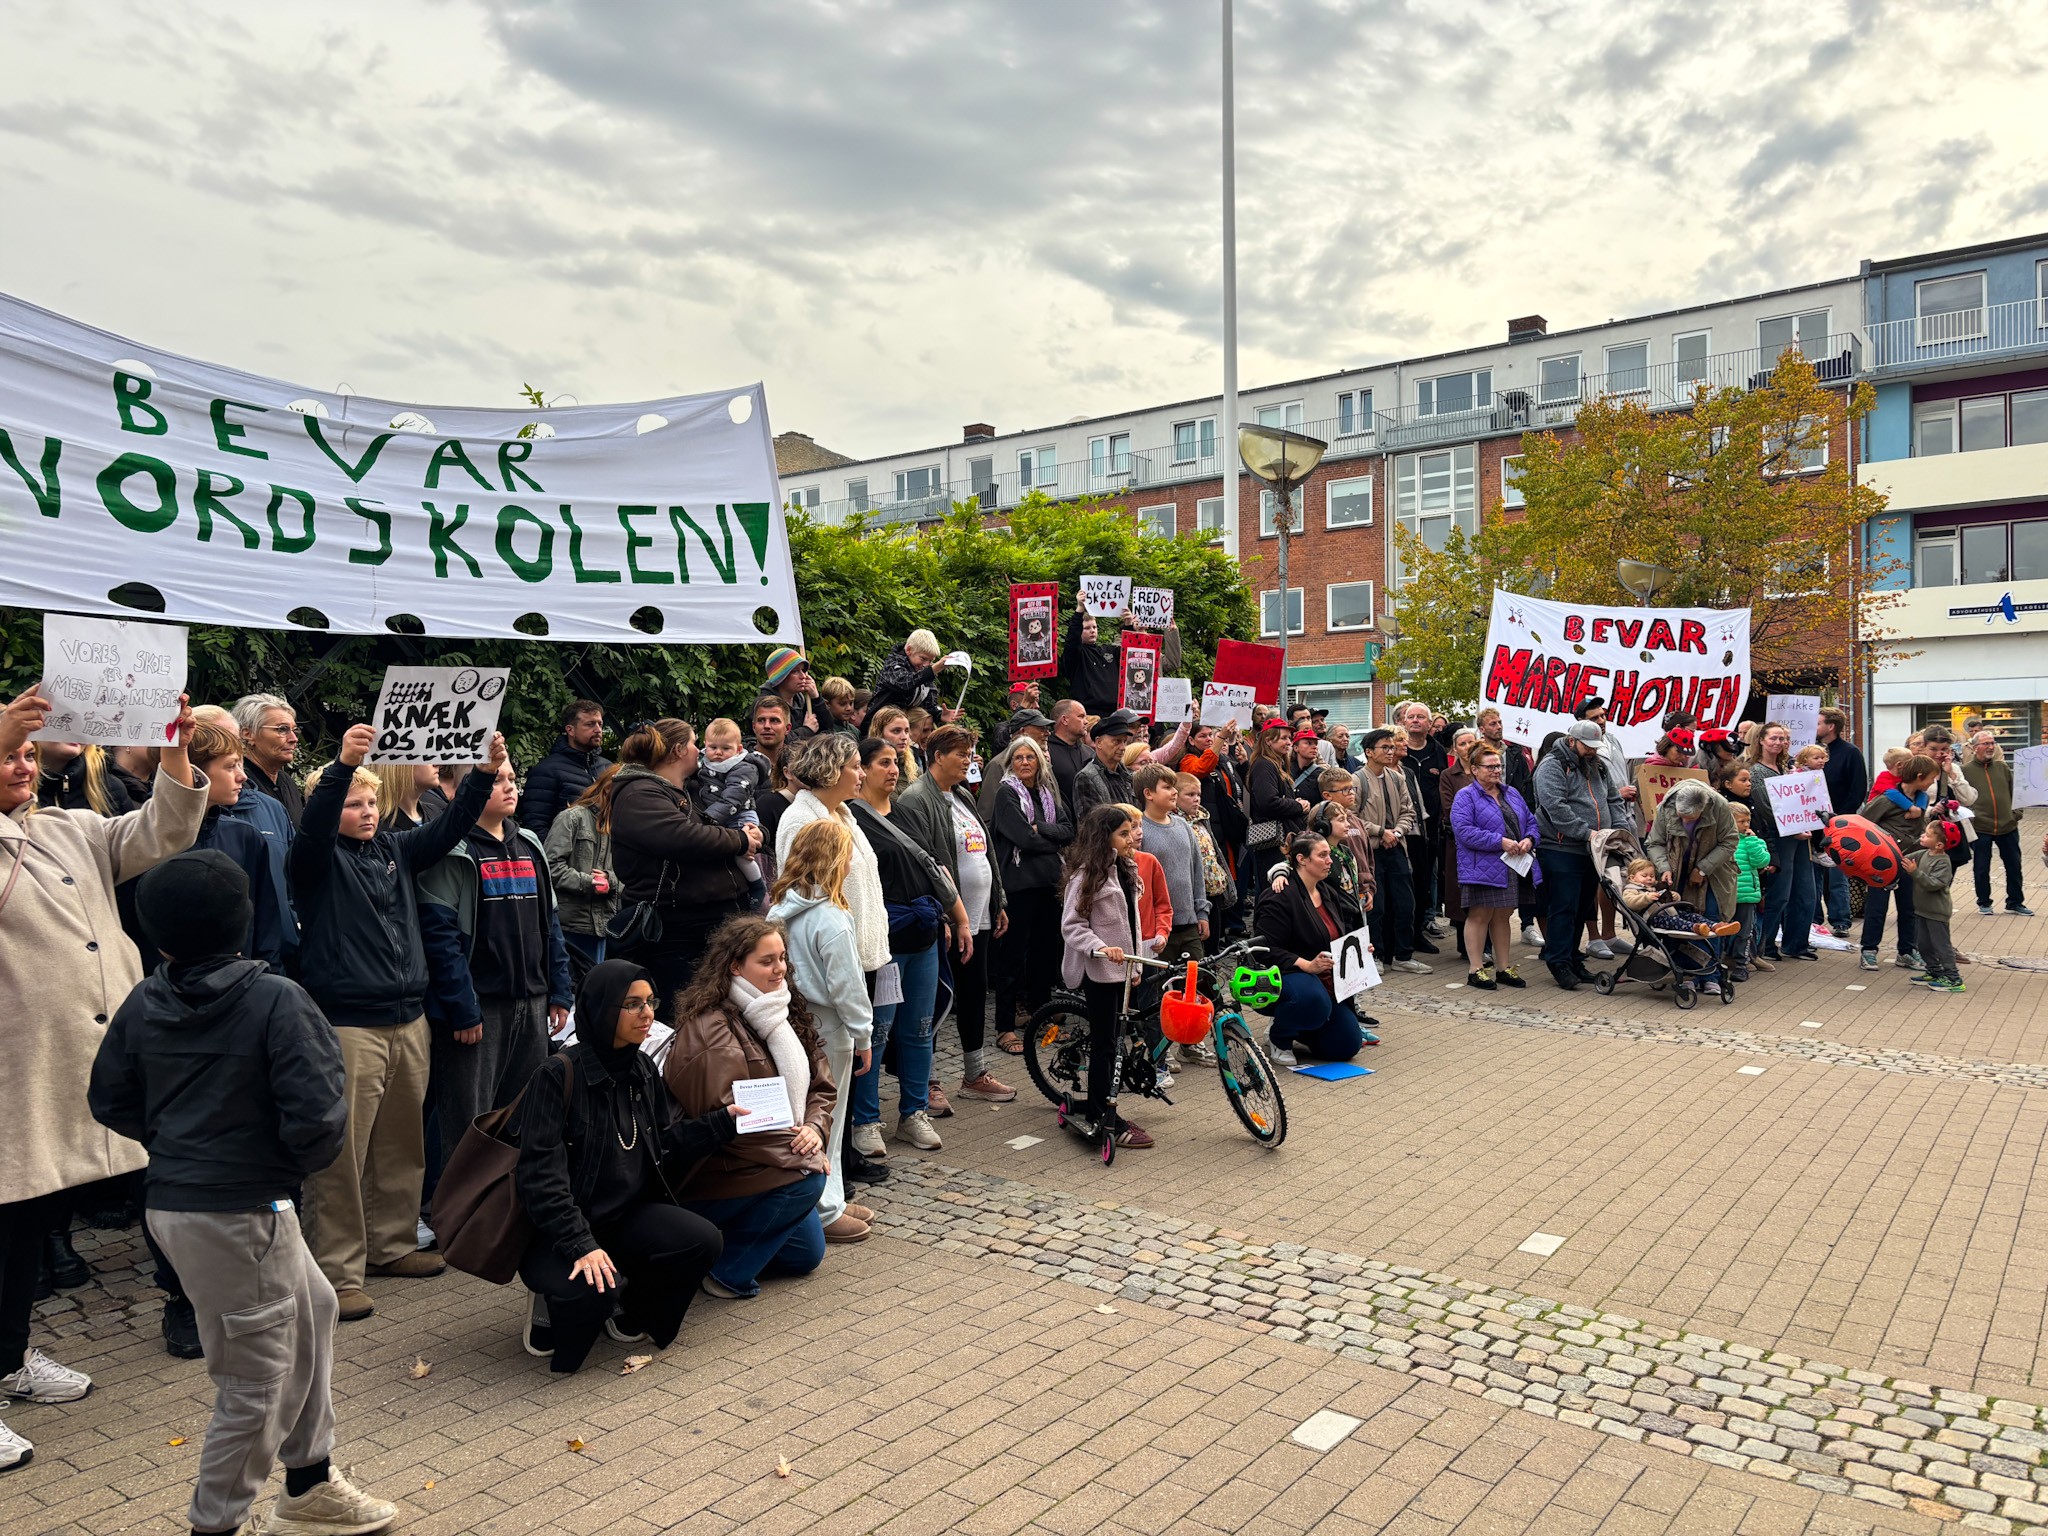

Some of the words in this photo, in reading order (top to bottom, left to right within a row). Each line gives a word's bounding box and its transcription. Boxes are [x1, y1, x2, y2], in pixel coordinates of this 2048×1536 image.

[113, 371, 545, 492] BEVAR
[1138, 591, 1160, 604] RED
[1139, 616, 1168, 625] SKOLEN
[1564, 615, 1707, 655] BEVAR
[60, 639, 120, 666] VORES
[134, 650, 171, 676] SKOLE
[104, 667, 123, 682] ER
[49, 675, 92, 701] MERE
[129, 687, 179, 708] MURSTE
[1770, 699, 1785, 711] Luk
[1792, 699, 1813, 711] ikke
[383, 700, 477, 730] KNÆK
[378, 730, 416, 751] OS
[1772, 783, 1806, 799] Vores
[486, 864, 532, 876] Champion
